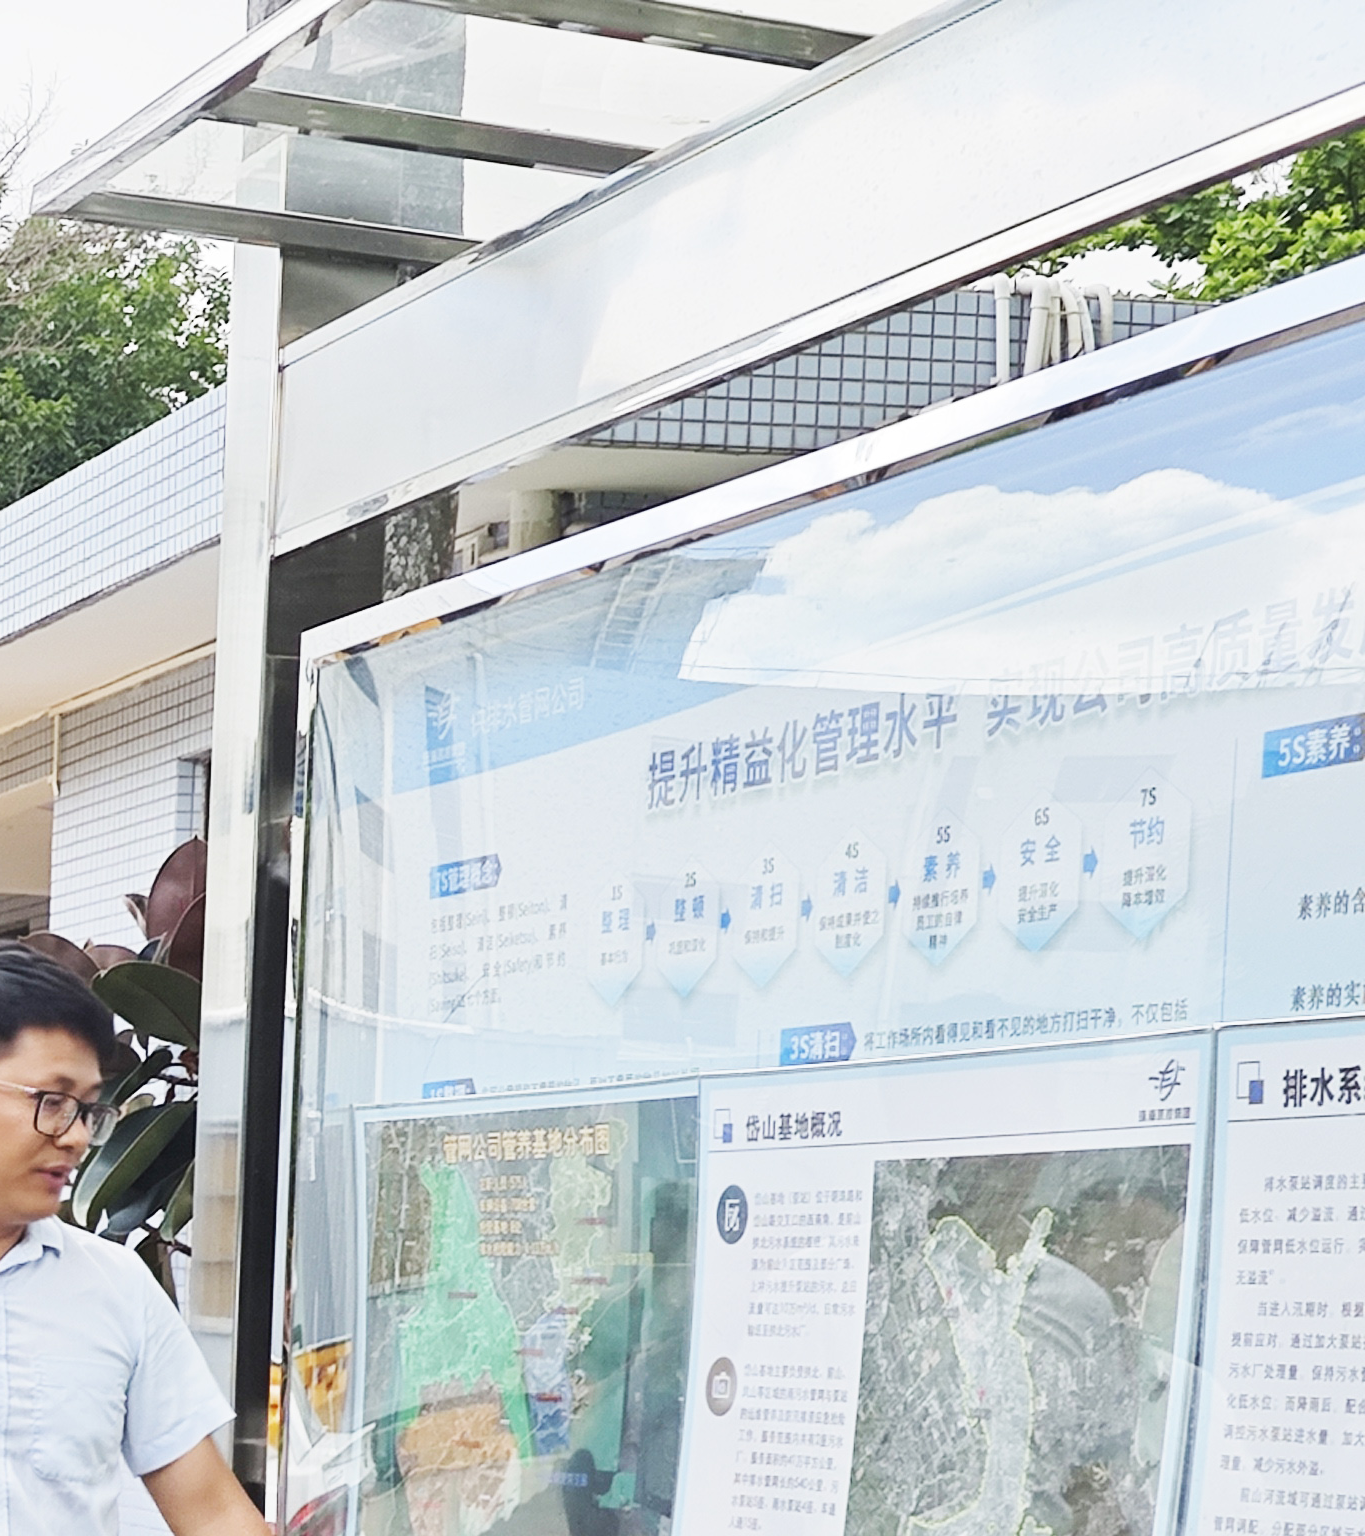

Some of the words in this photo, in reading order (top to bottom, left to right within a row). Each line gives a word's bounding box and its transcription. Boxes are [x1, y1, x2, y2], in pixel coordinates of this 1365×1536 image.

[648, 693, 957, 809] 提升精益化管理水平
[987, 588, 1365, 737] 实现公司高质量发
[1141, 787, 1157, 807] 7S
[1035, 807, 1049, 826] 6S
[936, 826, 951, 844] 5S
[1130, 816, 1165, 850] 节约
[845, 842, 859, 859] 4S
[1020, 836, 1061, 867] 安全
[762, 858, 774, 874] 3S
[923, 852, 961, 882] 素养
[685, 873, 696, 888] 2S
[833, 866, 869, 897] 清洁
[674, 895, 704, 922] 整顿
[750, 883, 783, 909] 清扫
[1297, 887, 1365, 920] 素养的含
[601, 908, 630, 933] 整理
[1017, 904, 1058, 925] 安全生产
[1290, 979, 1365, 1011] 素养的实
[1283, 1065, 1365, 1108] 排水系
[746, 1111, 842, 1142] 岱山基地概况
[1231, 1332, 1365, 1350] 提前应对，通过加大泵站
